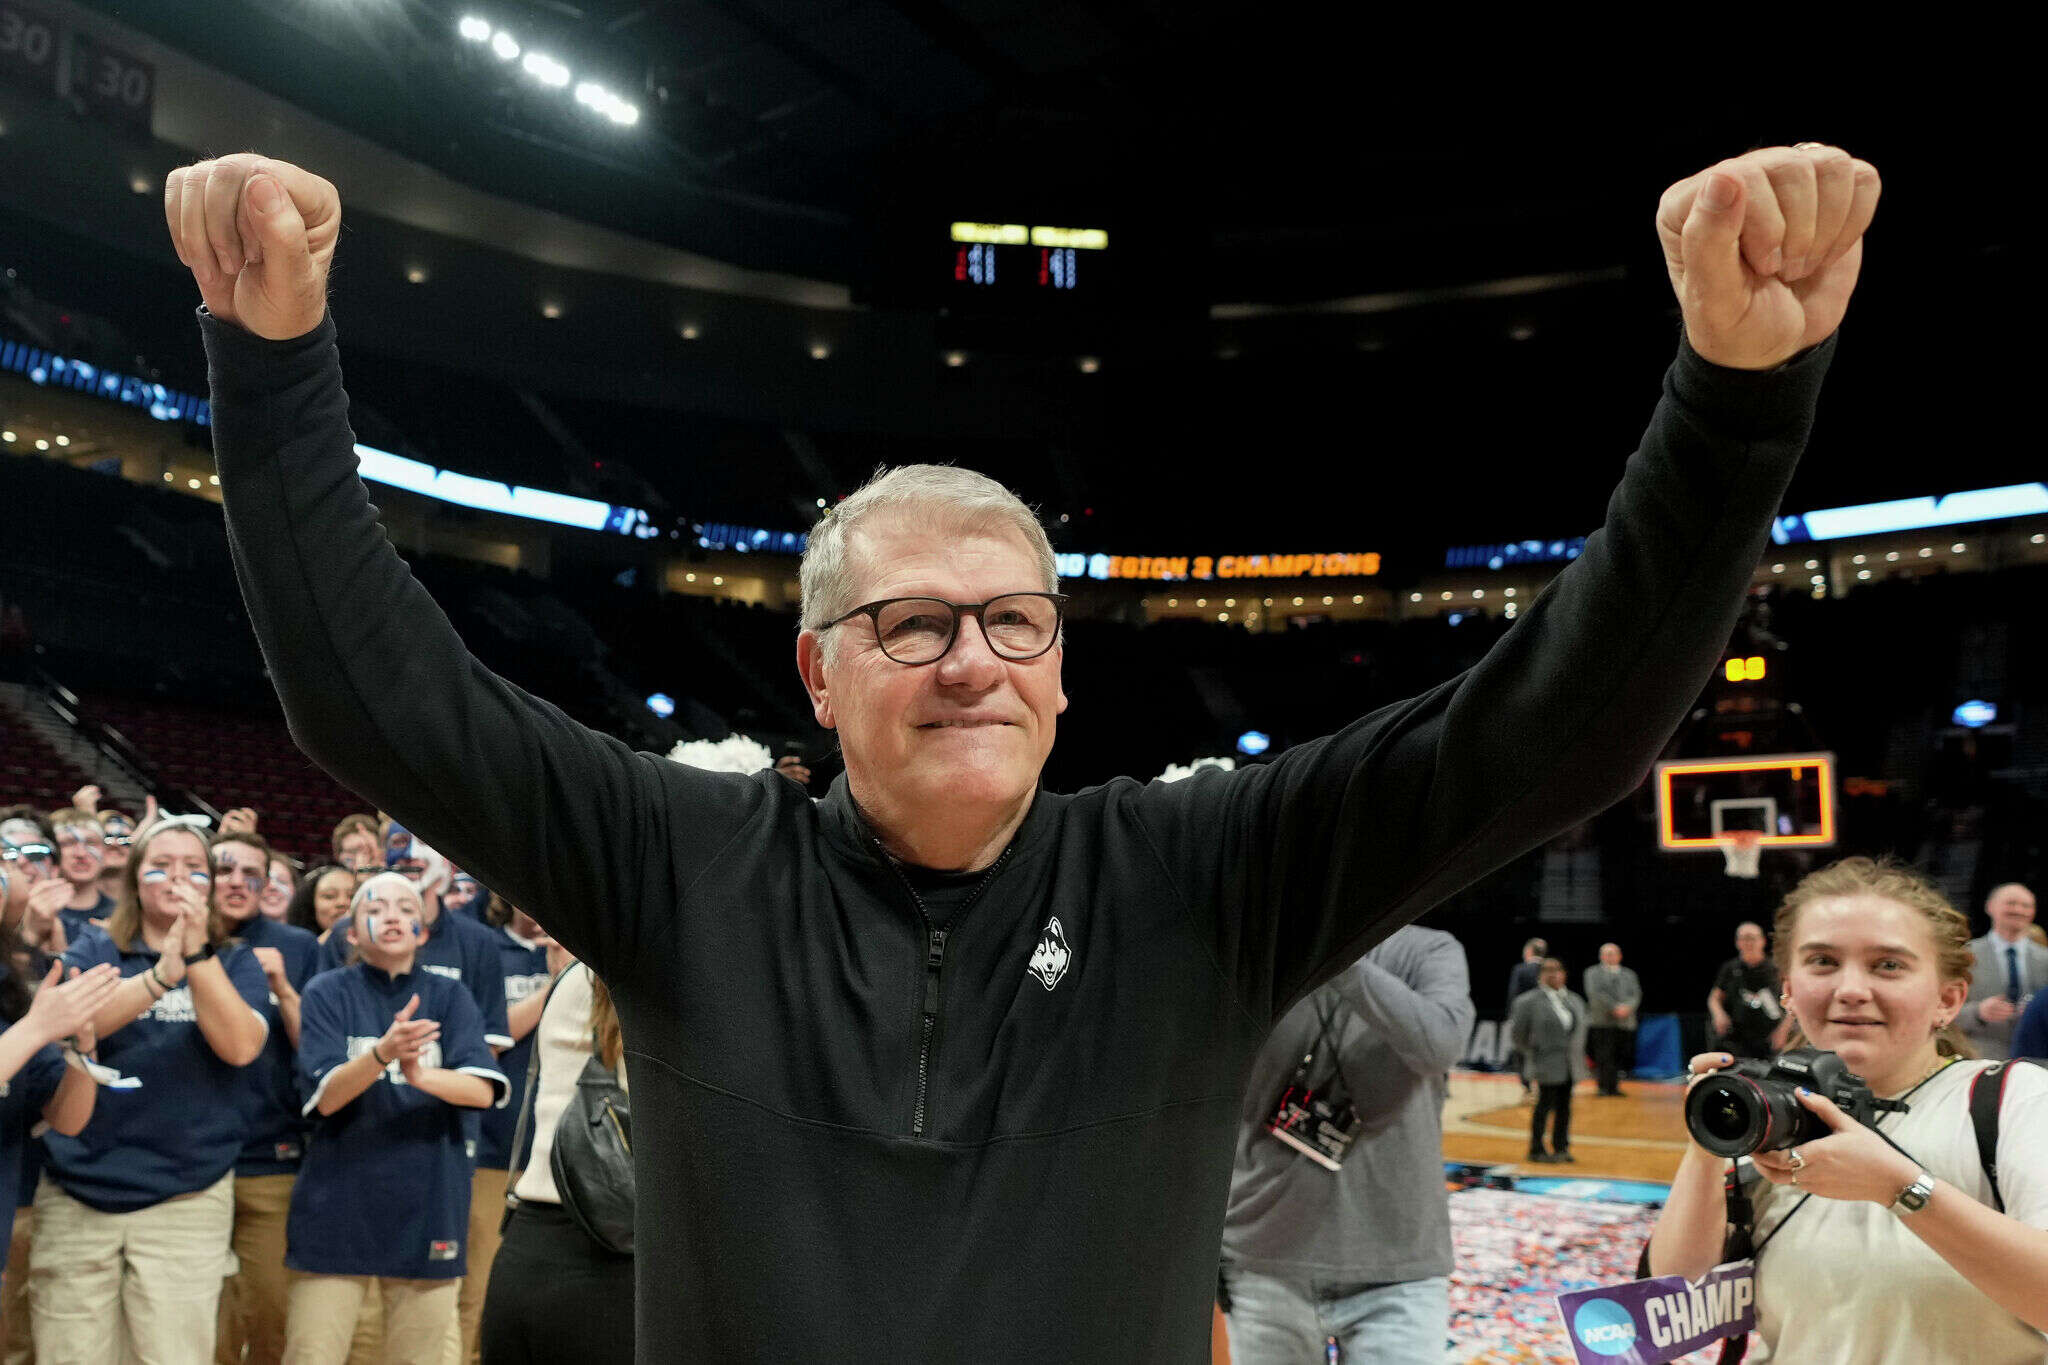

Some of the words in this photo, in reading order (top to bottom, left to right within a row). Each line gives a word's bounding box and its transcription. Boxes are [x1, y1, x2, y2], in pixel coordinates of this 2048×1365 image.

[1217, 552, 1381, 578] CHAMPIONS
[1644, 1277, 1753, 1349] CHAMP
[1584, 1323, 1636, 1345] NCAA
